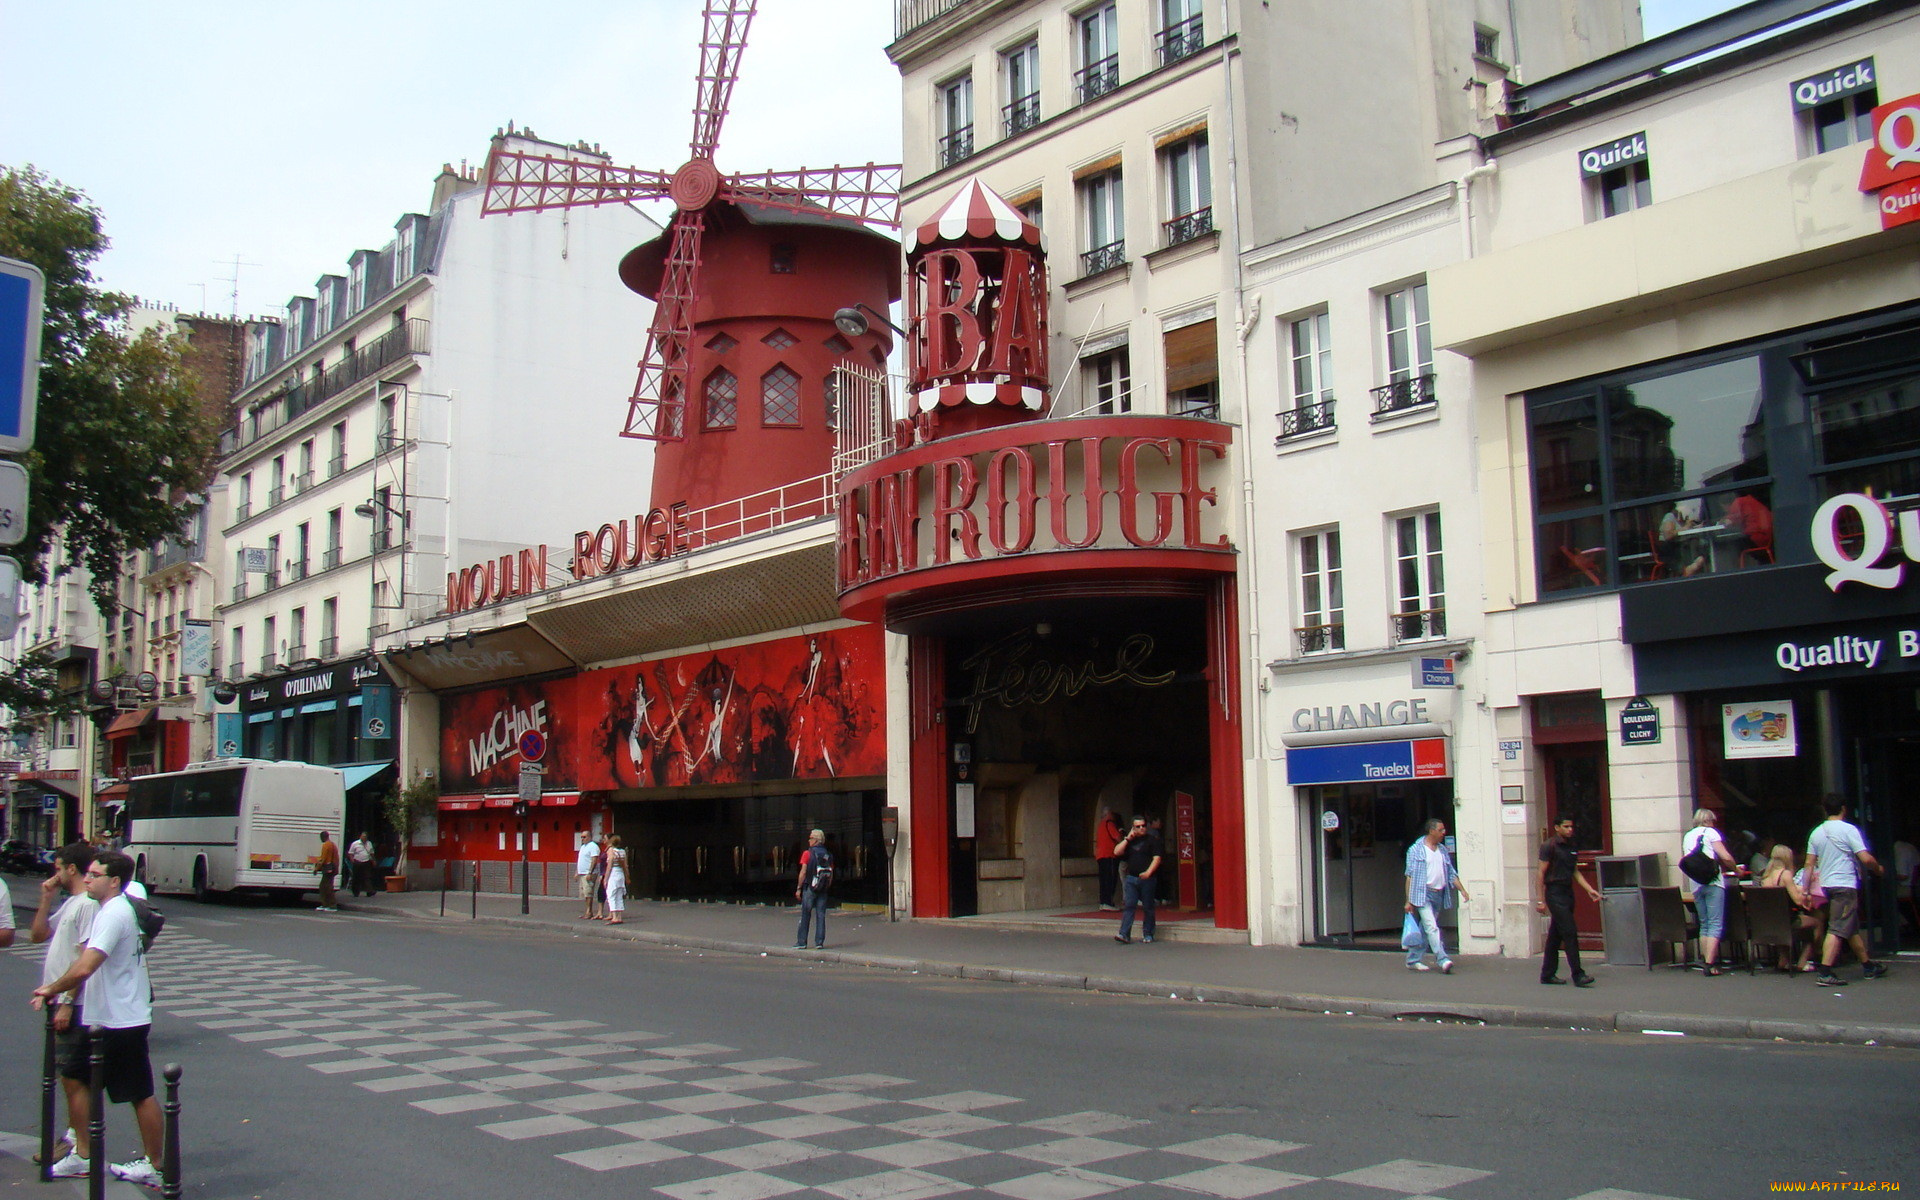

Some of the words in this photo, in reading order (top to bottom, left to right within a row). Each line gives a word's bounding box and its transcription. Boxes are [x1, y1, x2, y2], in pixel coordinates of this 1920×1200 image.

[1796, 64, 1873, 106] Quick
[1878, 106, 1920, 171] Q
[1582, 137, 1646, 173] Quick
[1881, 187, 1920, 214] Qui
[932, 436, 1231, 566] ROUGE
[446, 543, 547, 614] MOULIN
[574, 499, 692, 581] ROUGE
[1777, 631, 1882, 672] Quality
[285, 671, 334, 698] O'SULLIVANS
[1426, 674, 1450, 685] Change
[1292, 698, 1428, 732] CHANGE
[1623, 714, 1656, 724] BOULEVARD
[469, 699, 548, 777] MACHINE
[1500, 742, 1509, 750] 82
[1512, 741, 1520, 749] 84
[1629, 730, 1651, 739] CLICHY
[1416, 762, 1444, 770] worldwide
[1506, 751, 1515, 759] 86
[1362, 762, 1411, 778] Travelex
